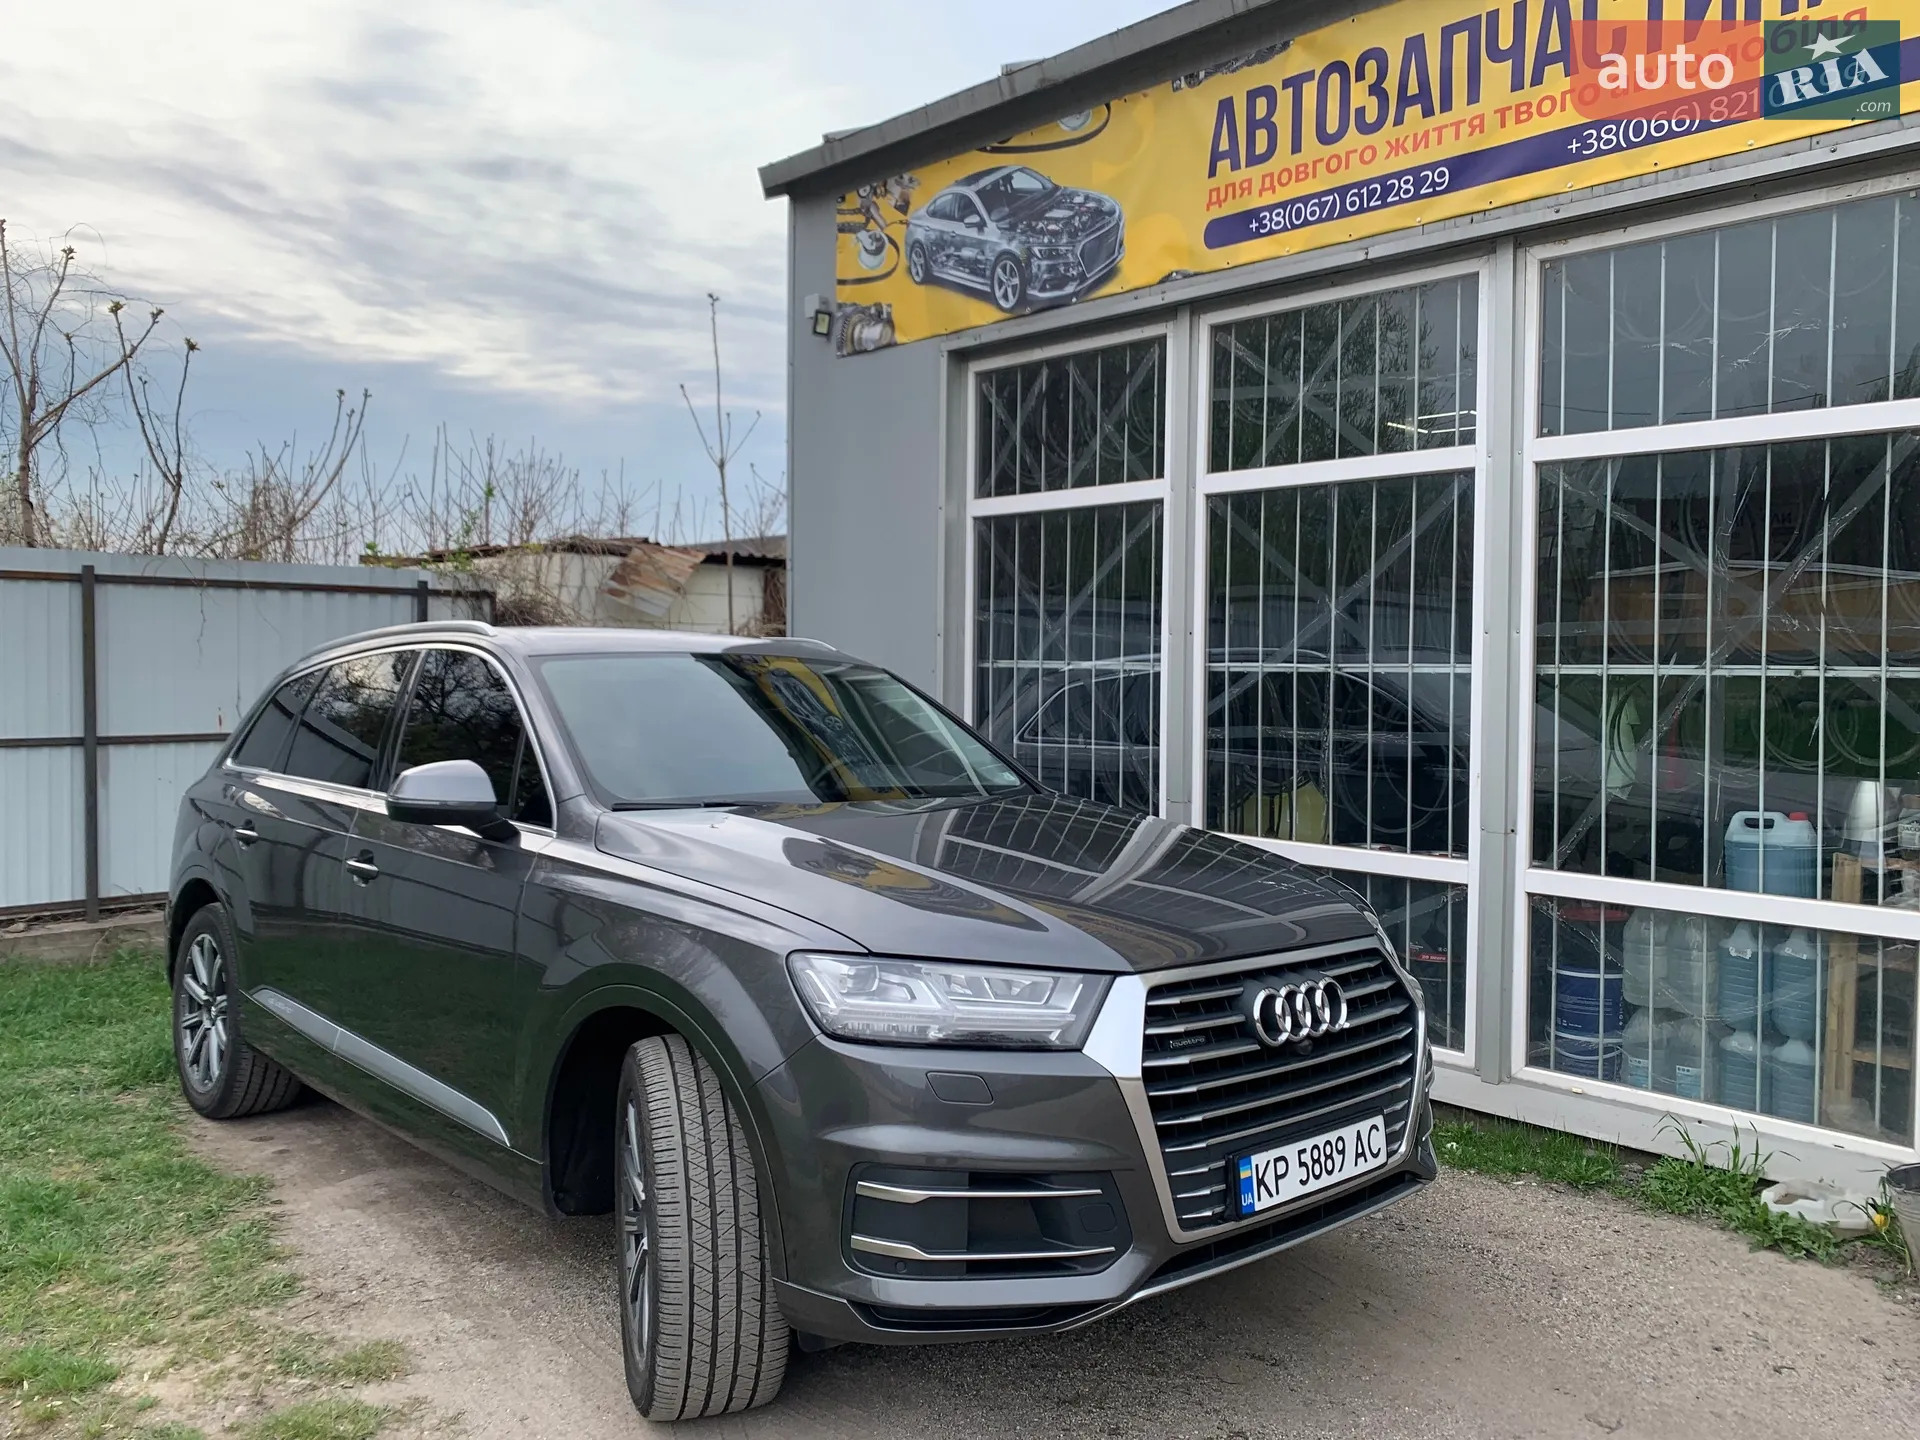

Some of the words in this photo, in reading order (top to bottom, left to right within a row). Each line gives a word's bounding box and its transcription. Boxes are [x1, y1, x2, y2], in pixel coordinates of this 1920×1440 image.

[1207, 0, 1822, 179] АВТОЗАПЧАС
[1567, 101, 1701, 155] +38(066)
[1708, 86, 1760, 123] 821
[1206, 177, 1253, 212] для
[1258, 144, 1378, 198] довгого
[1384, 112, 1486, 161] життя
[1493, 82, 1600, 130] твого
[1248, 192, 1341, 234] +38(067)
[1345, 183, 1382, 212] 612
[1386, 175, 1415, 203] 28
[1419, 166, 1450, 195] 29
[1241, 1192, 1254, 1207] UA
[1255, 1155, 1289, 1202] KP
[1297, 1135, 1346, 1186] 5889
[1354, 1123, 1382, 1167] AC
